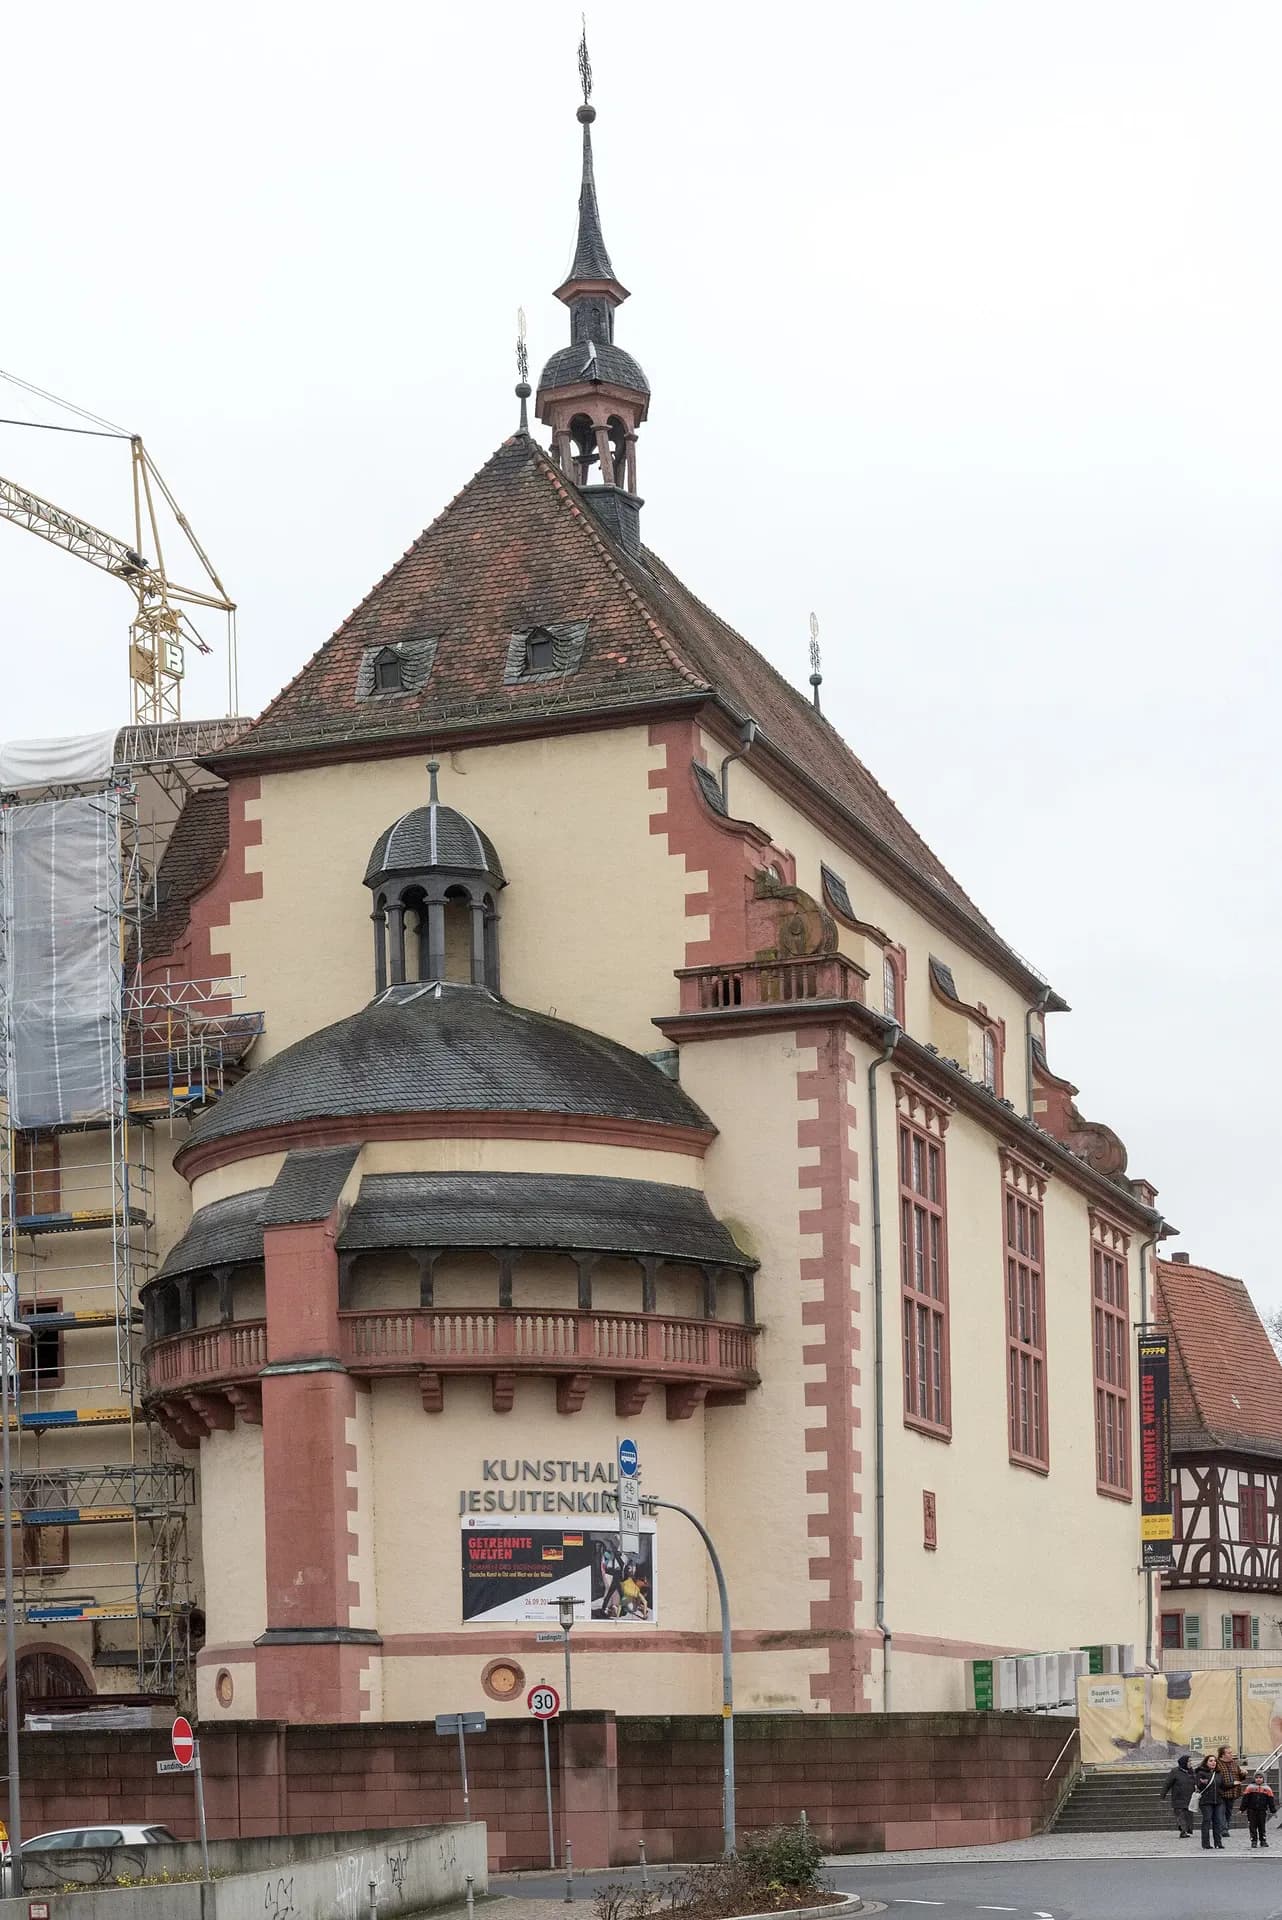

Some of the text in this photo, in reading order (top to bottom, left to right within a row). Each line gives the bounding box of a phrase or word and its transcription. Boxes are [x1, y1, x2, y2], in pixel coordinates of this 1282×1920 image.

[1142, 1375, 1156, 1503] GETRENNTE WELTEN
[483, 1460, 642, 1484] KUNSTHAL
[623, 1509, 637, 1521] TAXI
[468, 1537, 533, 1549] GETRENNTE
[469, 1548, 512, 1560] WELTEN
[534, 1694, 553, 1710] 30
